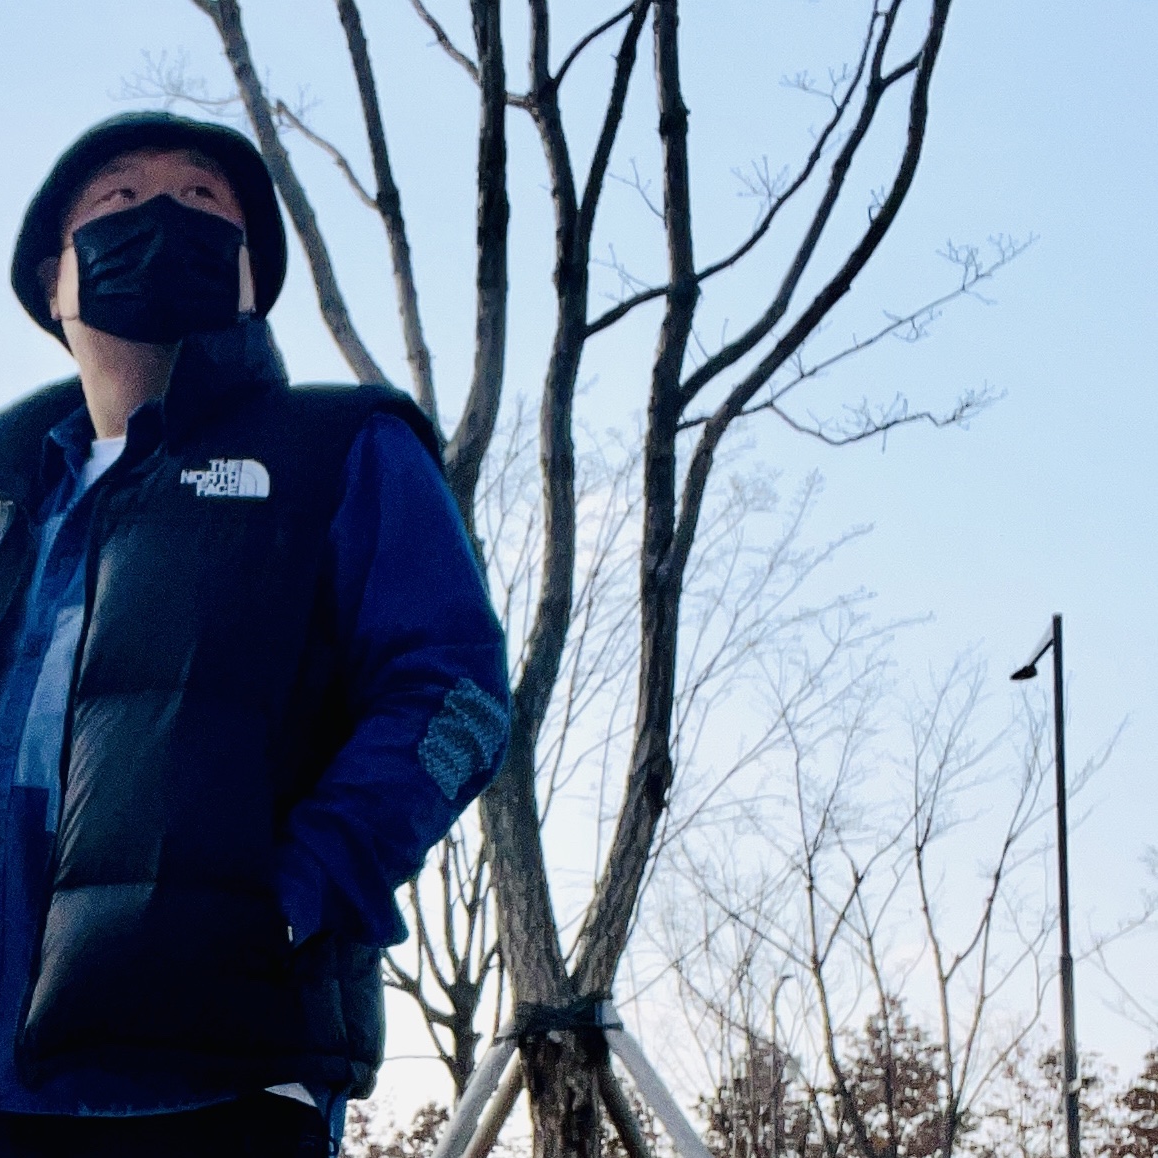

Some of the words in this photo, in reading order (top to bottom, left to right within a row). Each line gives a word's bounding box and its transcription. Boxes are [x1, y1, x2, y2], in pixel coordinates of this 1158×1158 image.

[209, 459, 242, 472] THE
[181, 470, 241, 484] NORTH
[196, 483, 240, 496] FACE
